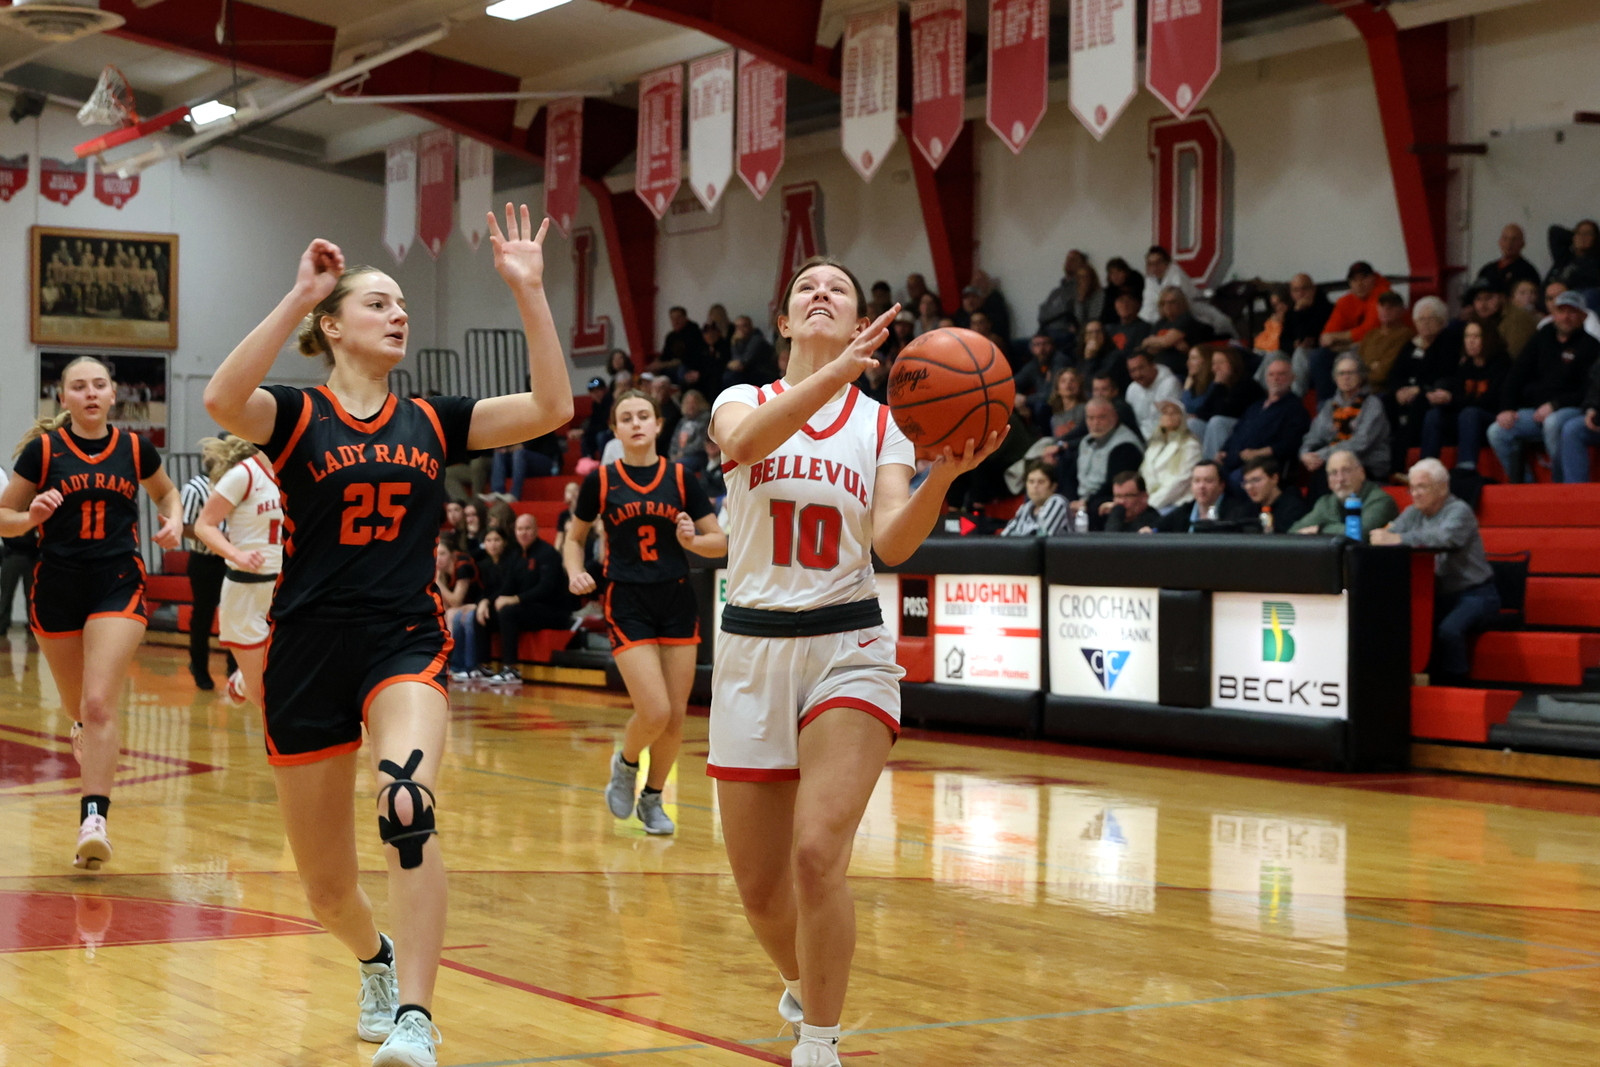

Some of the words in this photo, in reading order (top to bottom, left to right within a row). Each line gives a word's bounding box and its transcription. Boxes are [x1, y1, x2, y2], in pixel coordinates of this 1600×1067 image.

[307, 443, 367, 482] LADY
[374, 444, 439, 480] RAMS
[60, 473, 89, 496] ADY
[95, 473, 136, 499] RAMS
[79, 500, 106, 539] 11
[339, 482, 411, 546] 25
[608, 501, 642, 526] LADY
[646, 501, 680, 524] RAM
[637, 525, 659, 561] 2
[769, 498, 843, 572] 10
[903, 596, 928, 617] POSS
[945, 583, 1028, 604] LAUGHLIN
[1219, 675, 1340, 707] BECK'S
